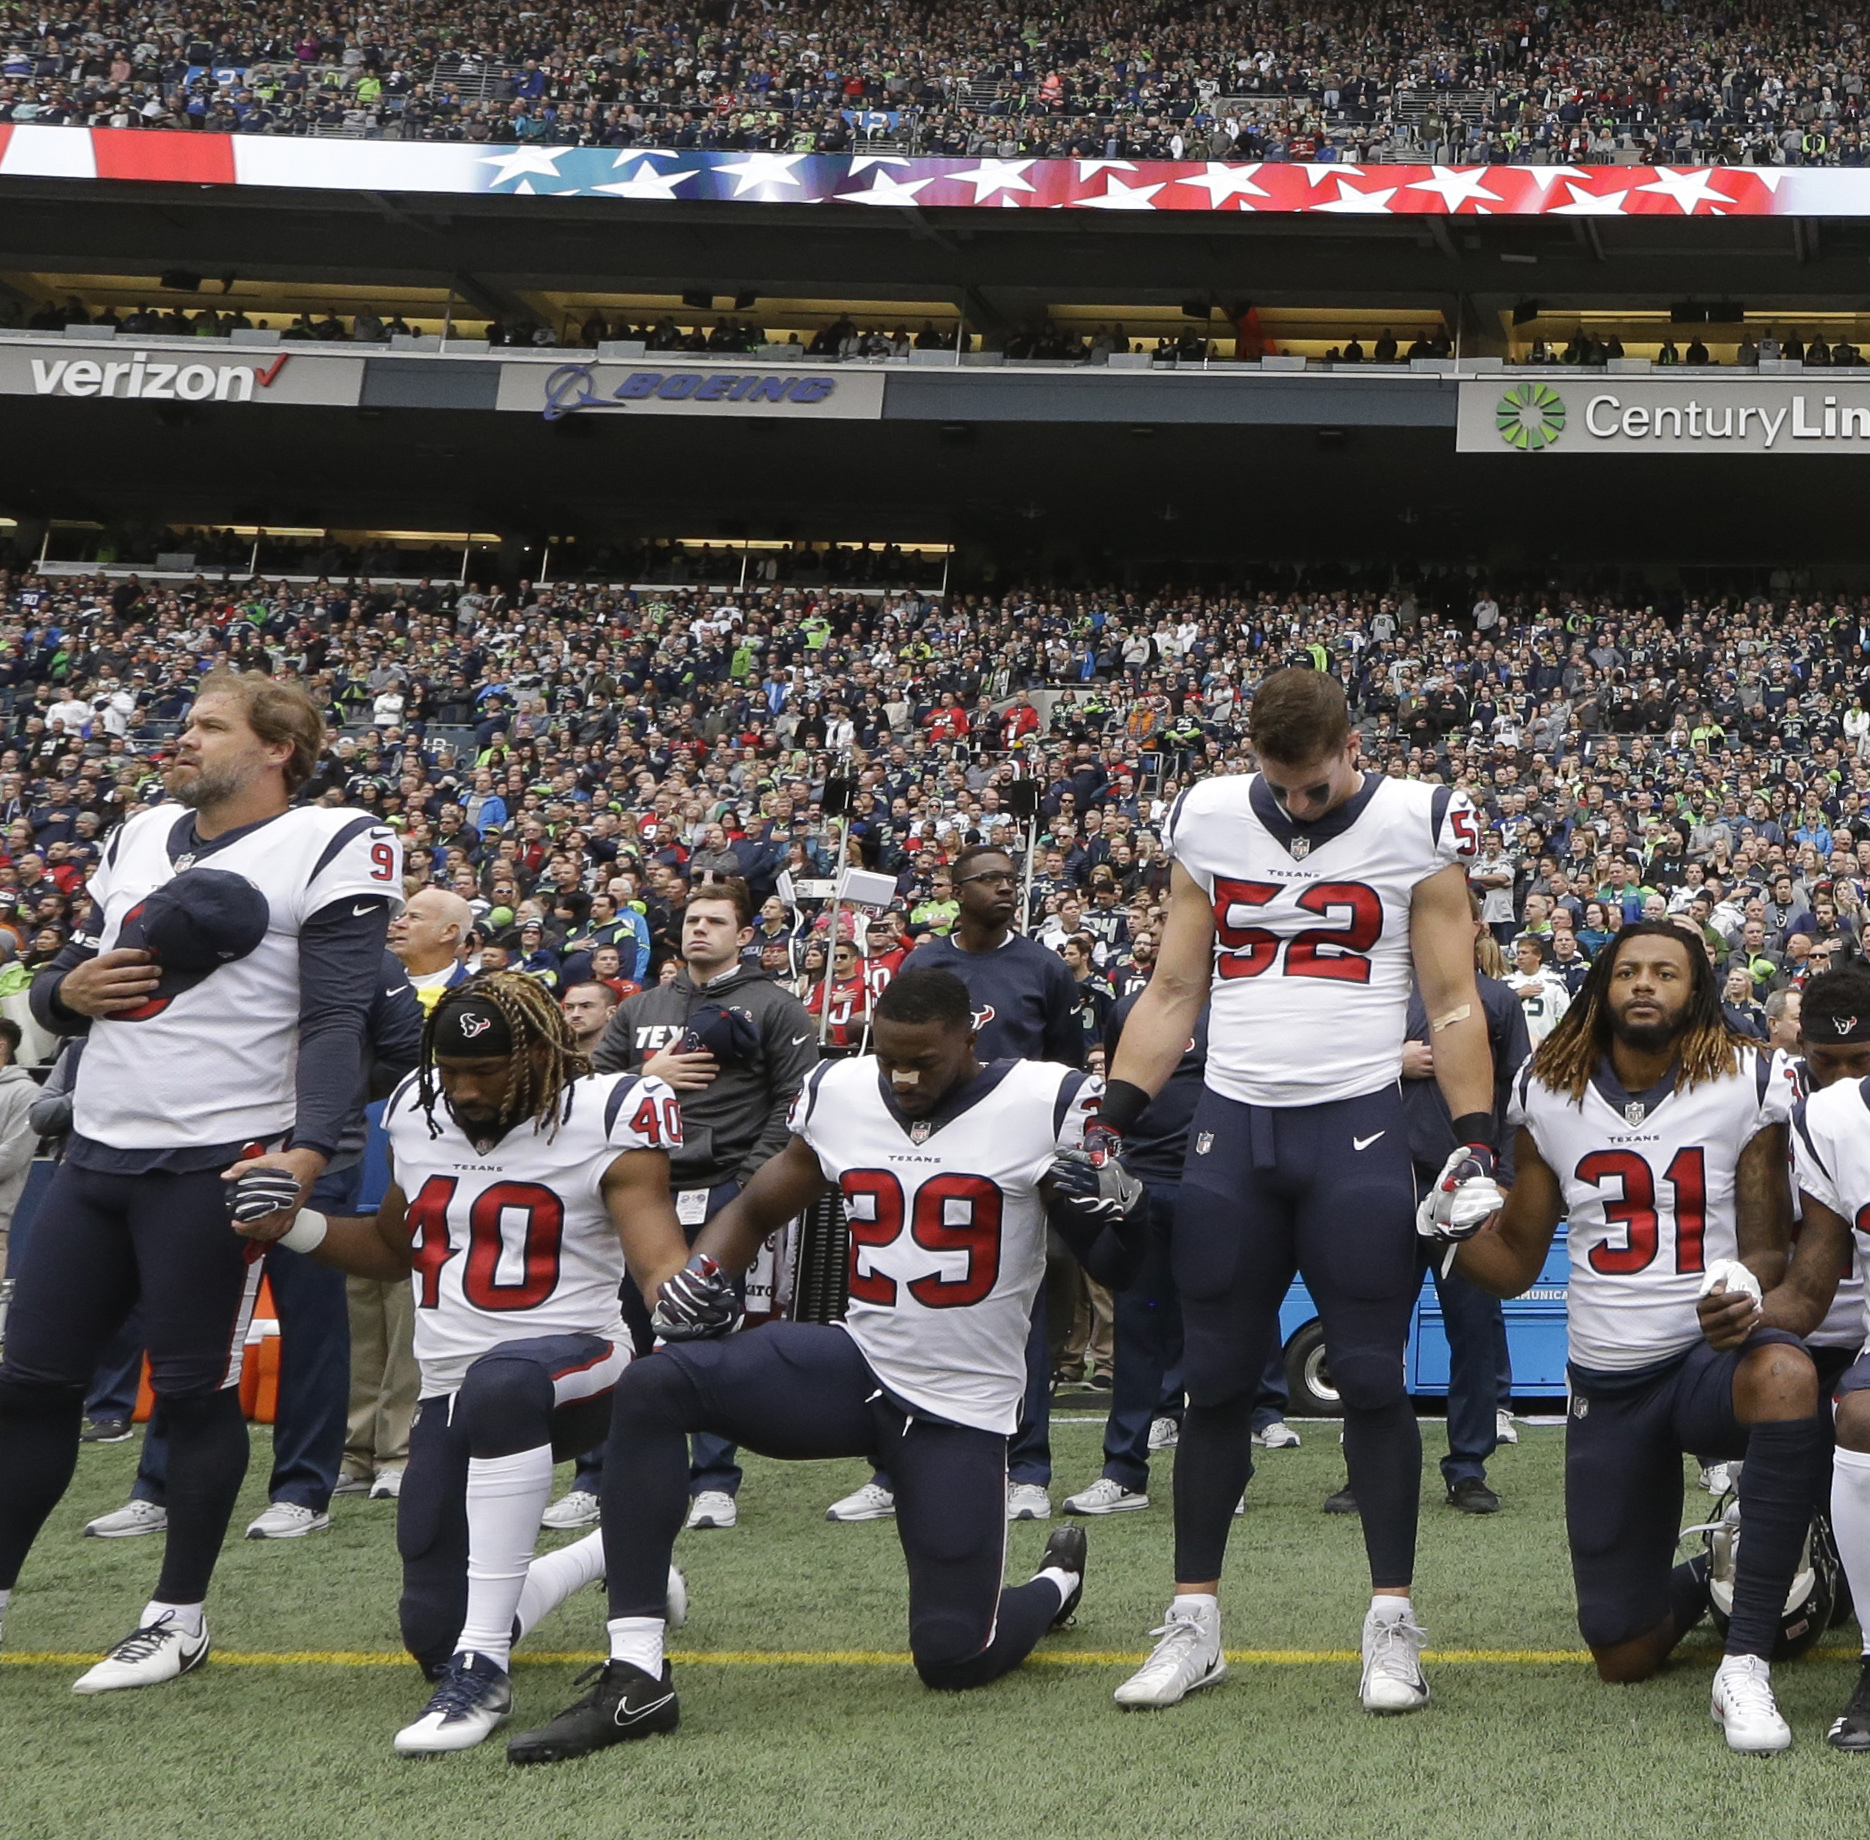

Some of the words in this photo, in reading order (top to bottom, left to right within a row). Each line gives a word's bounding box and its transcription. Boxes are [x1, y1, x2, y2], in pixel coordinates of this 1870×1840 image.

[32, 352, 257, 401] verizon
[614, 373, 837, 404] BOEING
[1176, 718, 1194, 732] 25
[643, 824, 658, 841] 9
[370, 843, 394, 882] 9
[1266, 869, 1321, 879] TEXANS
[1213, 875, 1384, 984] 52
[629, 1096, 684, 1144] 40
[1607, 1135, 1660, 1143] TEXANS
[452, 1163, 504, 1173] TEXANS
[888, 1154, 942, 1165] TEXANS
[1575, 1146, 1705, 1276] 31
[404, 1173, 565, 1313] 40
[840, 1167, 1004, 1310] 29
